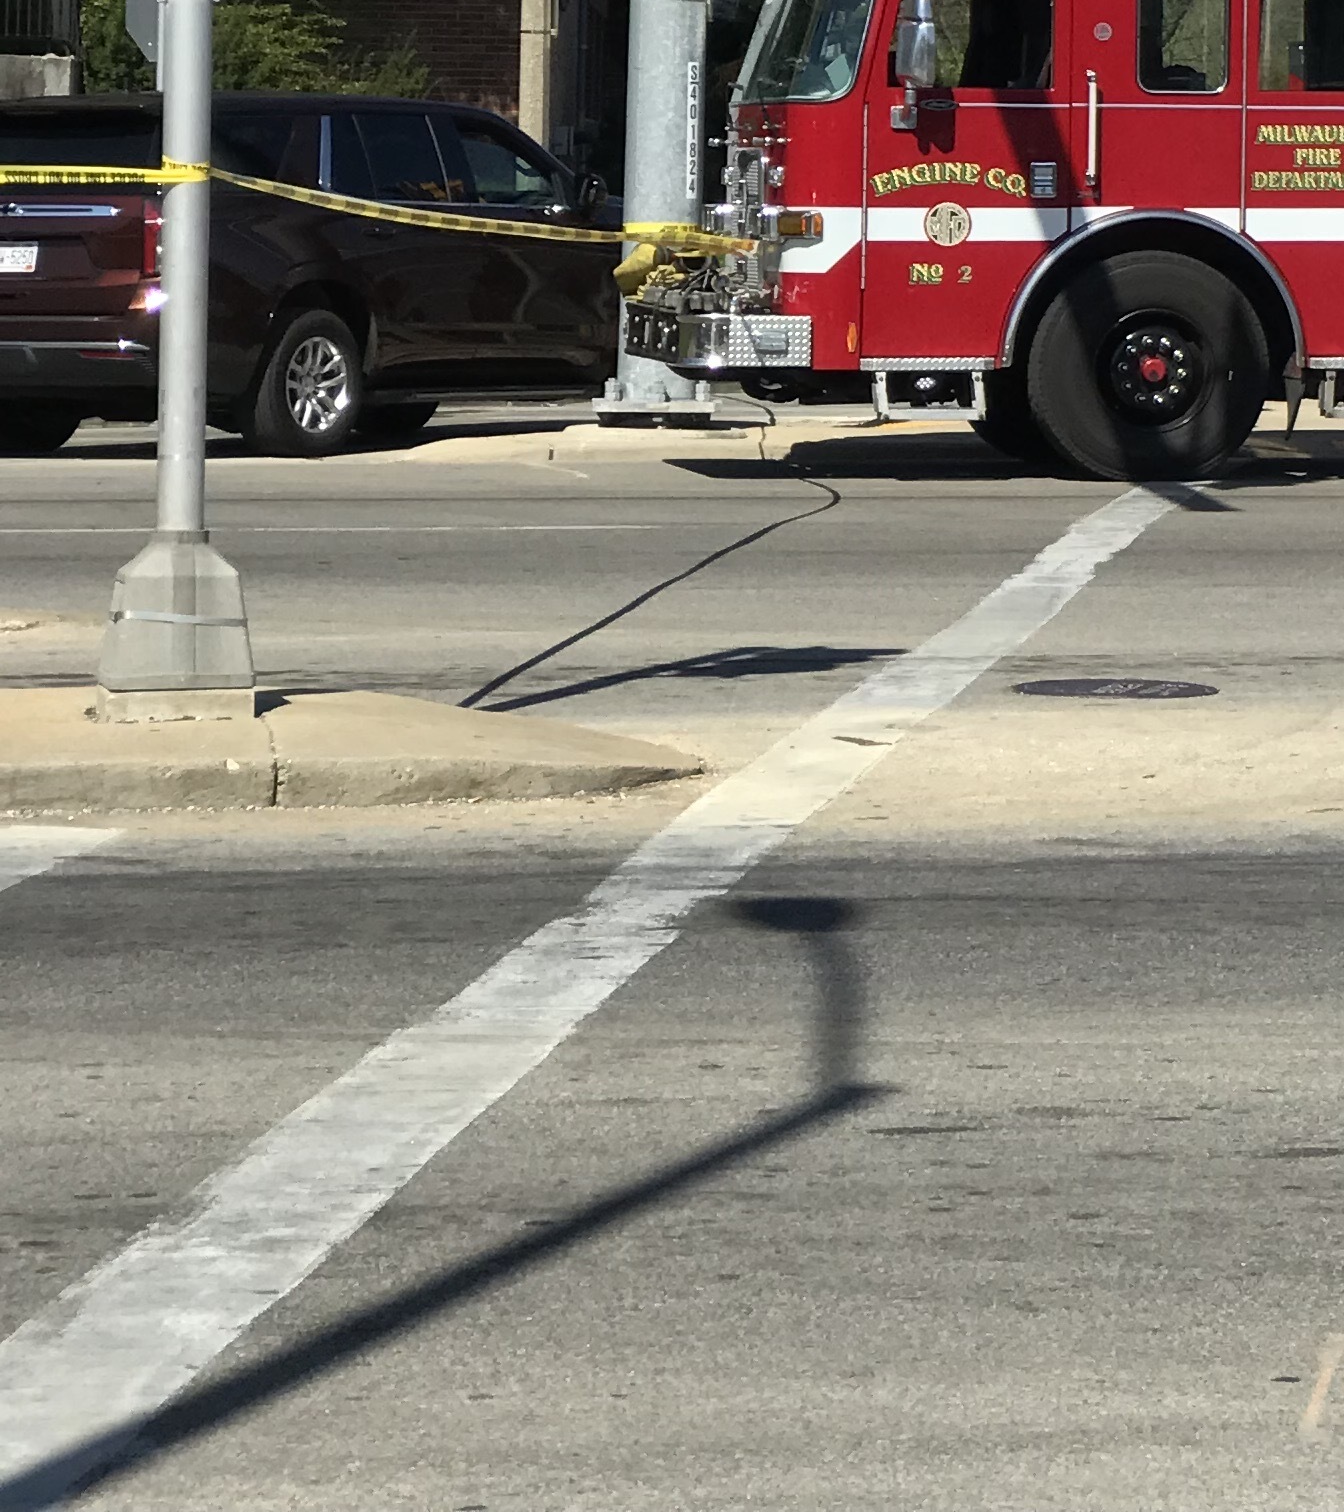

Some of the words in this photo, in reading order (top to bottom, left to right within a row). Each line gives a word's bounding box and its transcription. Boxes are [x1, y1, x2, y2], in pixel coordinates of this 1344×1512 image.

[1293, 148, 1342, 168] FIRE
[870, 162, 981, 197] ENGINE
[957, 265, 973, 284] 2
